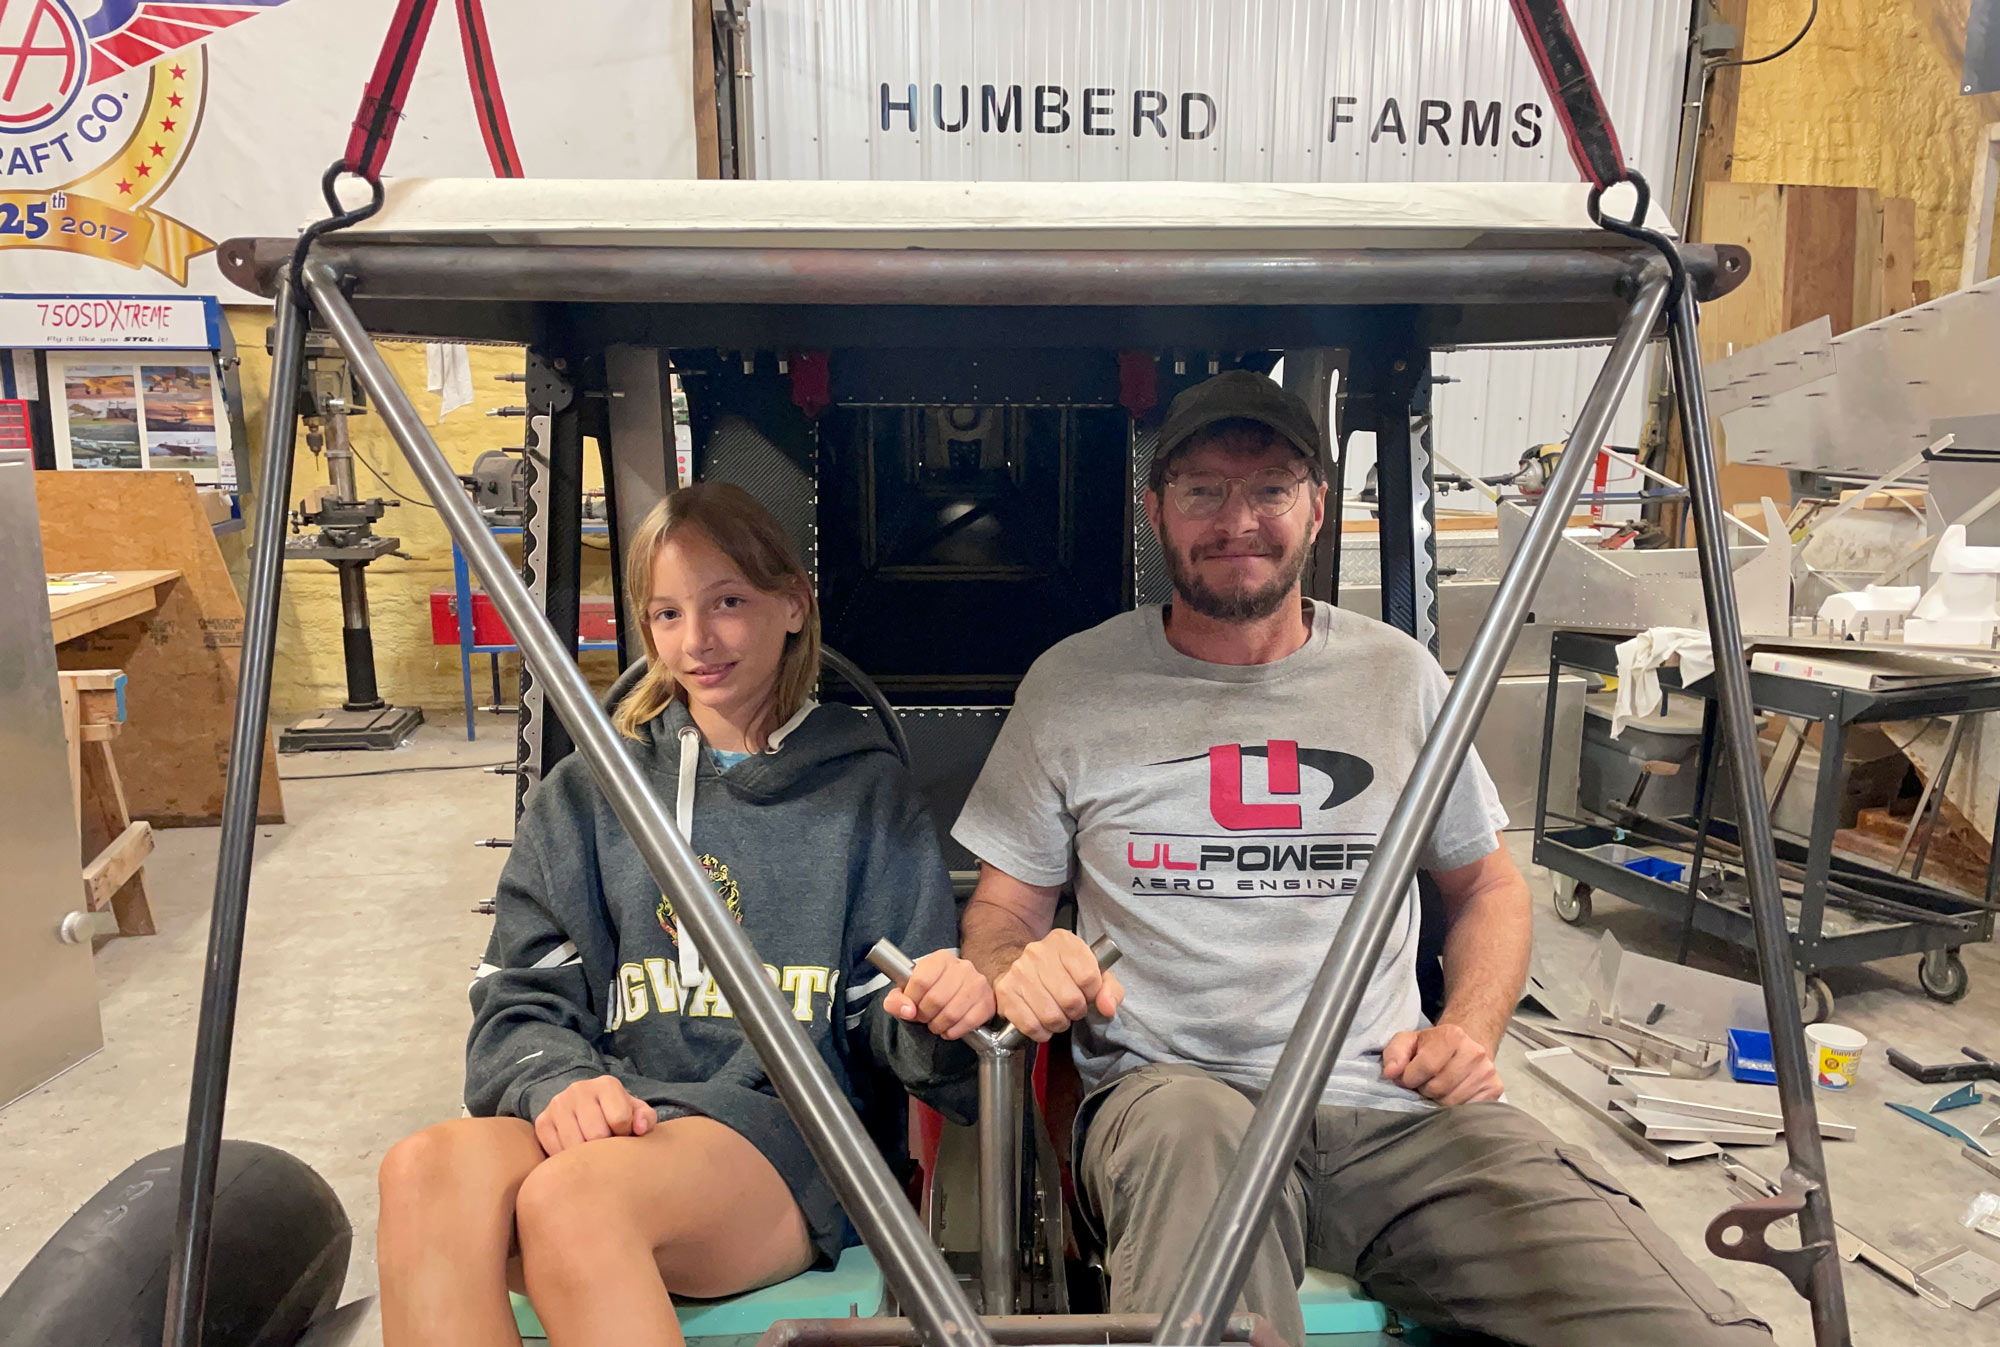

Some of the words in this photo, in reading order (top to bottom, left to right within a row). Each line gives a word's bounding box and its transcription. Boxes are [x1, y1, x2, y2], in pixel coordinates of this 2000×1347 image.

[77, 93, 128, 143] CO.
[880, 82, 1217, 140] HUMBERD
[1327, 96, 1543, 148] FARMS
[61, 217, 128, 243] 2017
[1132, 876, 1214, 891] AERO
